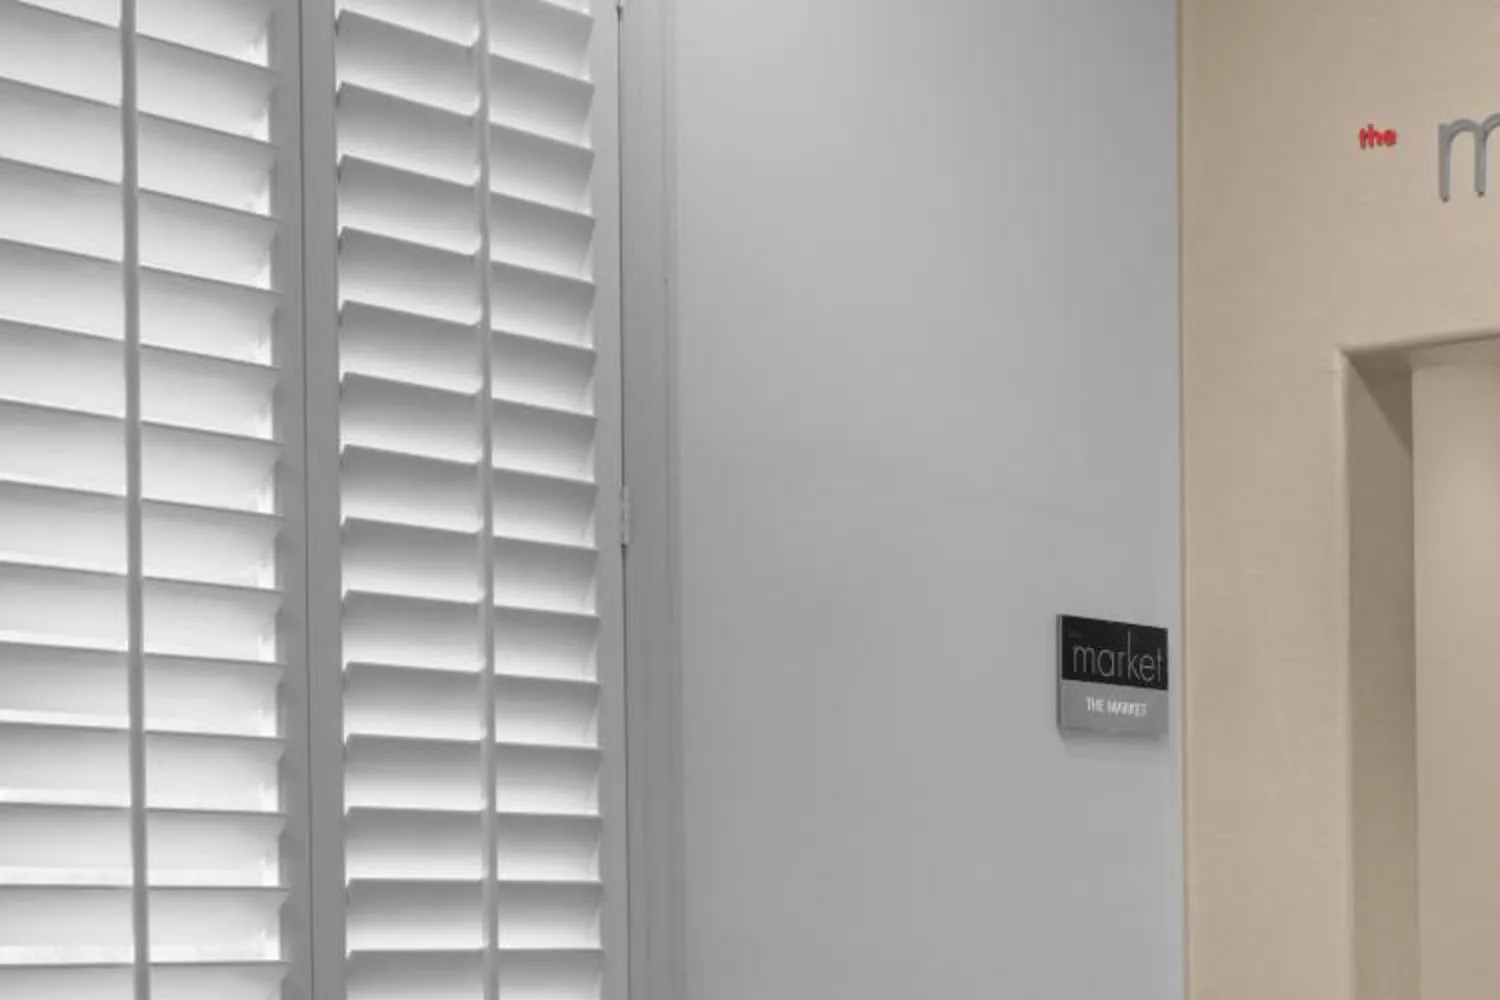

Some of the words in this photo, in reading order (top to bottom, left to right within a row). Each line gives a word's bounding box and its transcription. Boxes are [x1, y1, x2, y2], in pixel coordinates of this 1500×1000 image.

[1359, 124, 1397, 150] the
[1072, 630, 1165, 683] market
[1085, 697, 1105, 712] THE
